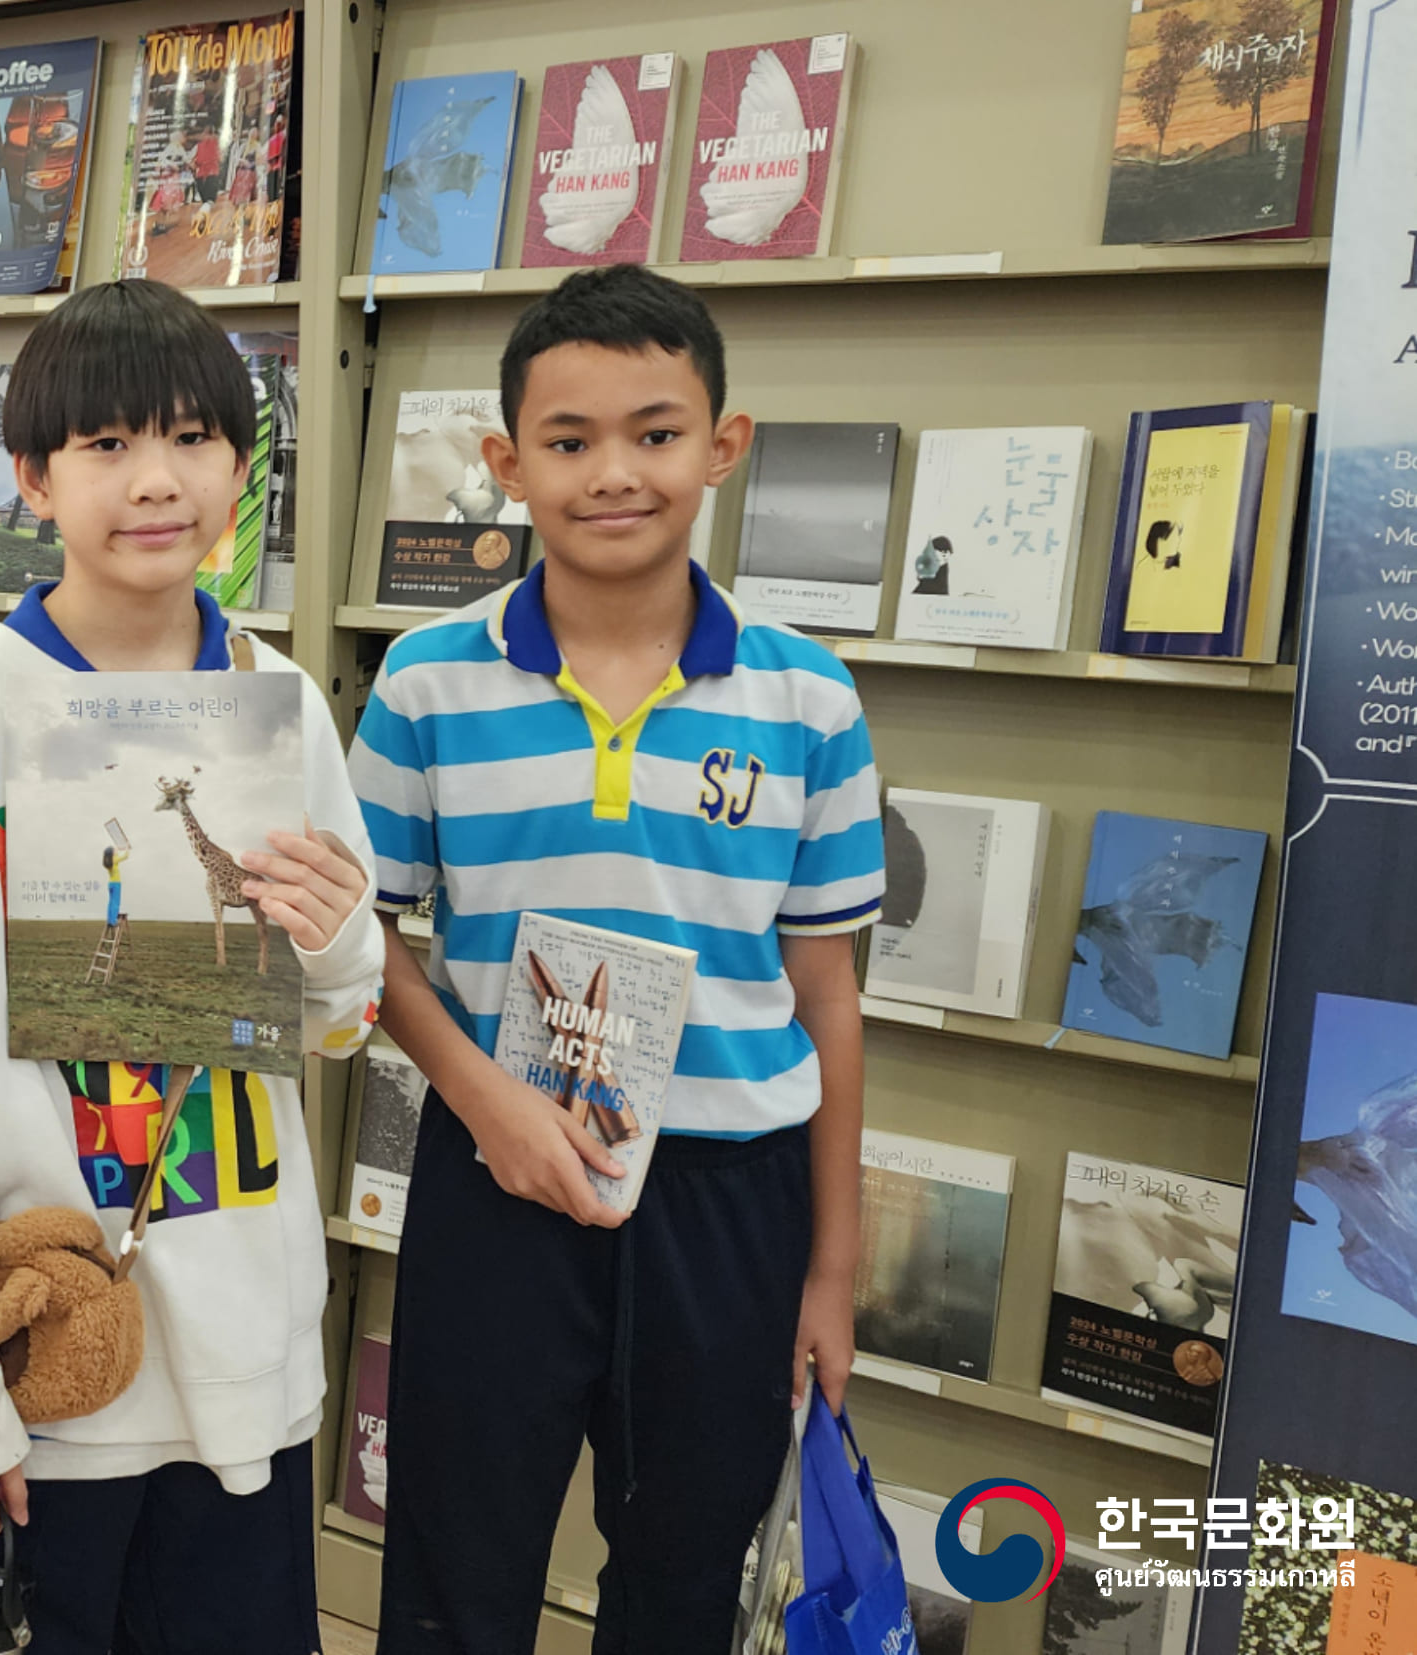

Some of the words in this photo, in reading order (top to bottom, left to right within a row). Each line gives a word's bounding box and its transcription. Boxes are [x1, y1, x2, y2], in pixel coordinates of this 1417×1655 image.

[1196, 28, 1308, 72] 채식주의자
[585, 124, 615, 144] THE
[750, 110, 782, 131] THE
[538, 141, 657, 175] VEGETARIAN
[699, 127, 829, 165] VEGETARIAN
[555, 175, 586, 194] HAN
[591, 171, 631, 192] KANG
[717, 162, 751, 184] HAN
[755, 158, 800, 180] KANG
[66, 698, 122, 719] 희망을
[127, 698, 183, 719] 부르는
[188, 697, 240, 719] 어린이
[698, 748, 765, 829] SJ
[542, 996, 636, 1048] HUMAN
[548, 1034, 616, 1076] ACTS
[526, 1062, 565, 1093] HAN
[570, 1076, 625, 1113] KANG
[1069, 1163, 1127, 1193] 그대의
[1132, 1175, 1193, 1205] 차가운
[1196, 1189, 1222, 1213] 손
[1067, 1332, 1090, 1348] 수상
[1093, 1338, 1117, 1355] 작가
